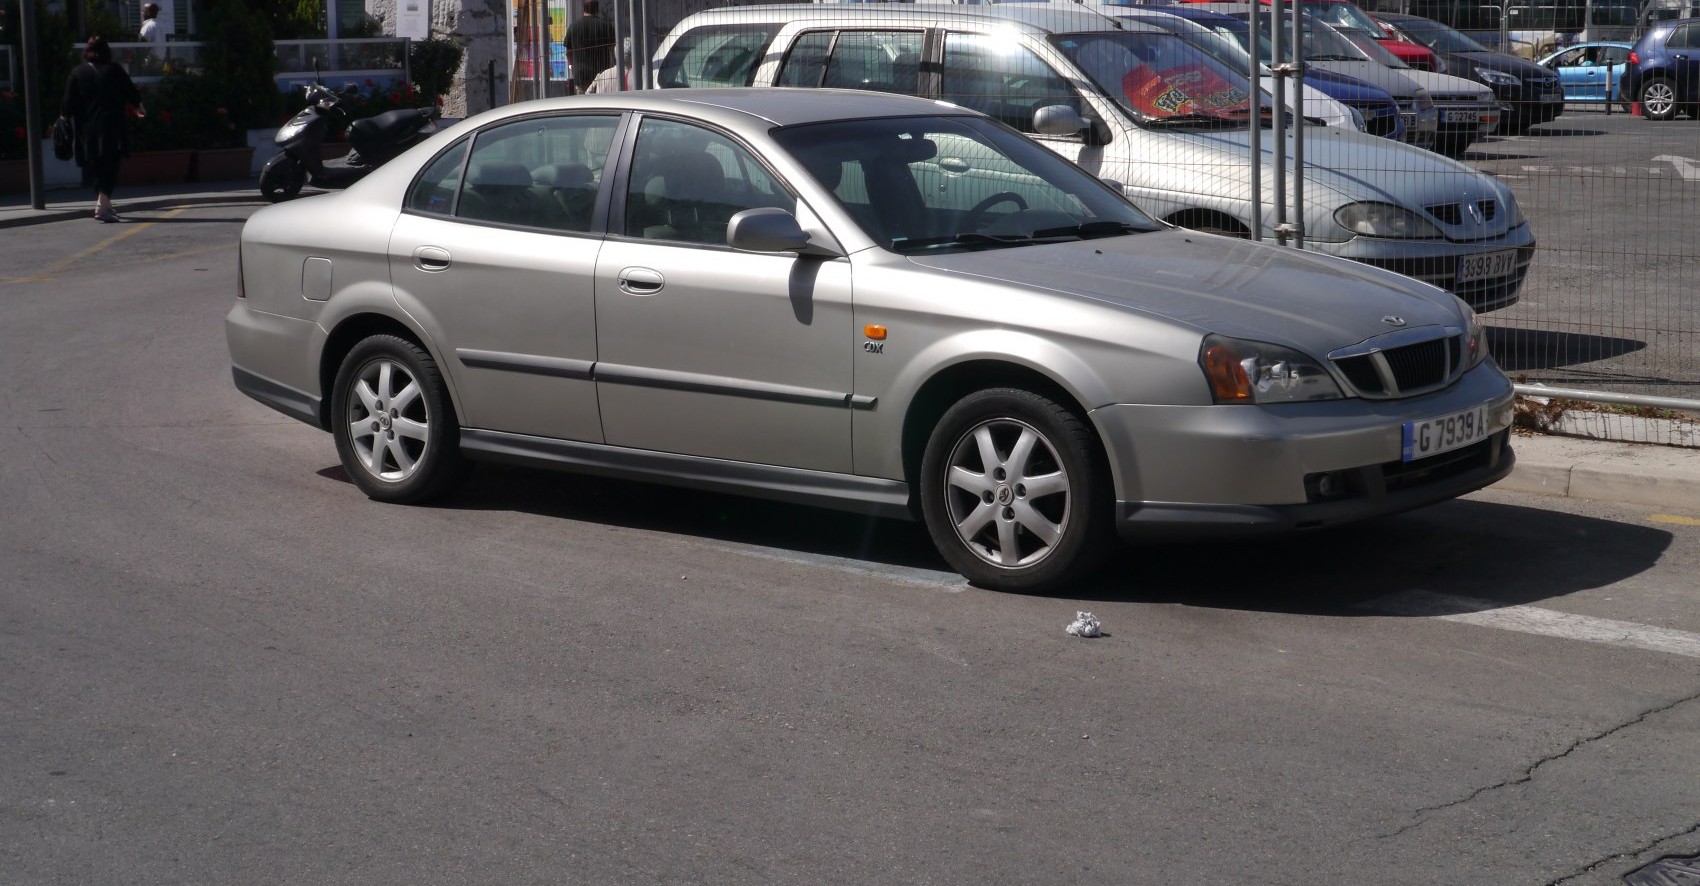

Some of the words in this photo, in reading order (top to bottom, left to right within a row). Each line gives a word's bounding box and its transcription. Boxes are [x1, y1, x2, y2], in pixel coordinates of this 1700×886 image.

[864, 341, 884, 354] CDX
[1420, 423, 1430, 452] G
[1435, 411, 1474, 449] 7939
[1477, 408, 1484, 436] A
